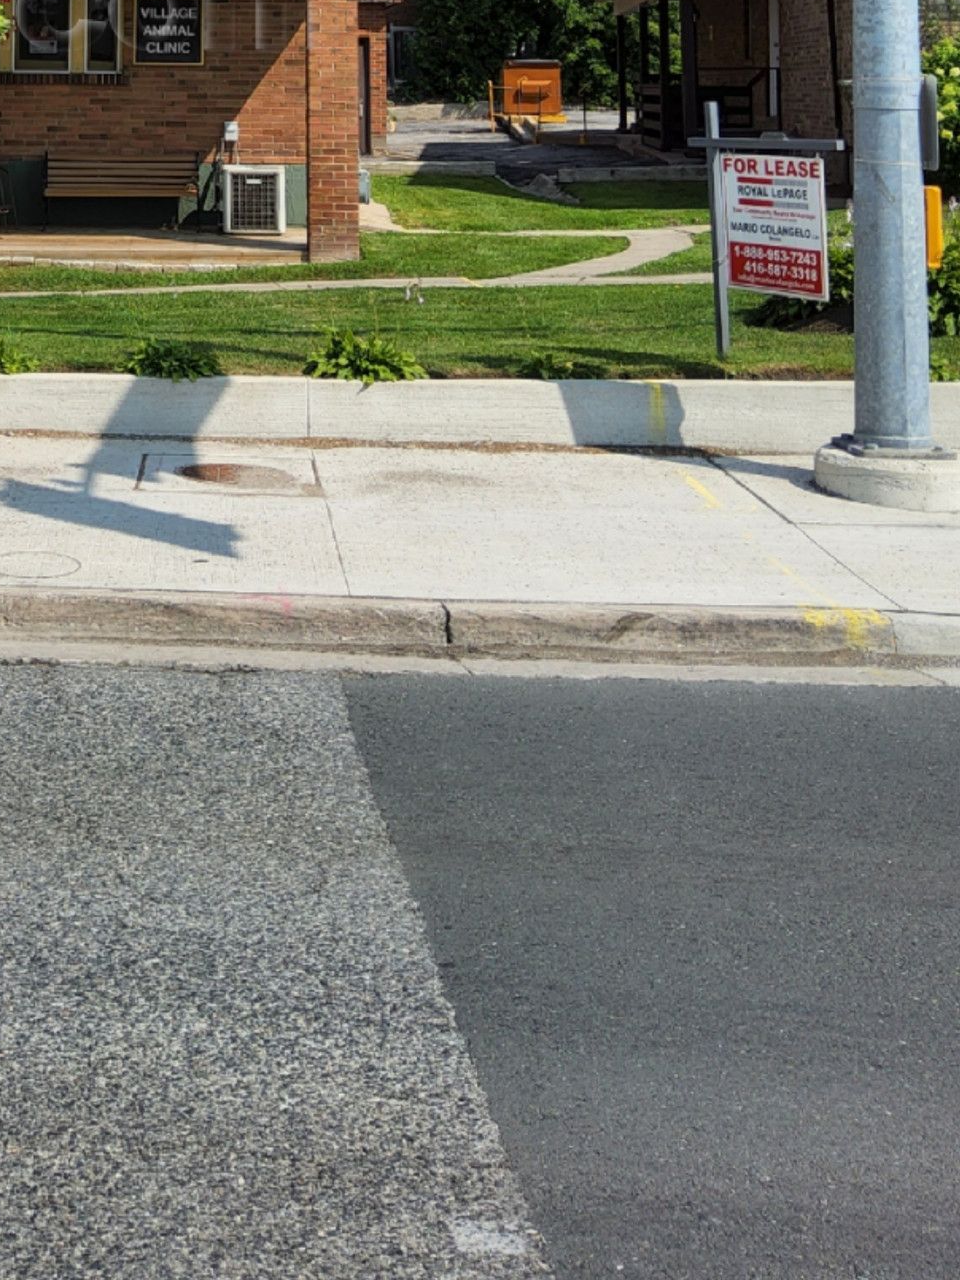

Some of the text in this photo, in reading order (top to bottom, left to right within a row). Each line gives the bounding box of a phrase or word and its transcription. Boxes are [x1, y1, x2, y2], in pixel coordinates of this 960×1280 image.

[141, 7, 198, 19] VILLAGE
[143, 25, 195, 37] ANIMAL
[146, 41, 191, 54] CLINIC
[723, 158, 820, 179] FOR LEASE
[737, 185, 808, 200] ROYAL LePAGE
[730, 221, 758, 234] MARIO
[760, 224, 811, 239] COLANGELO
